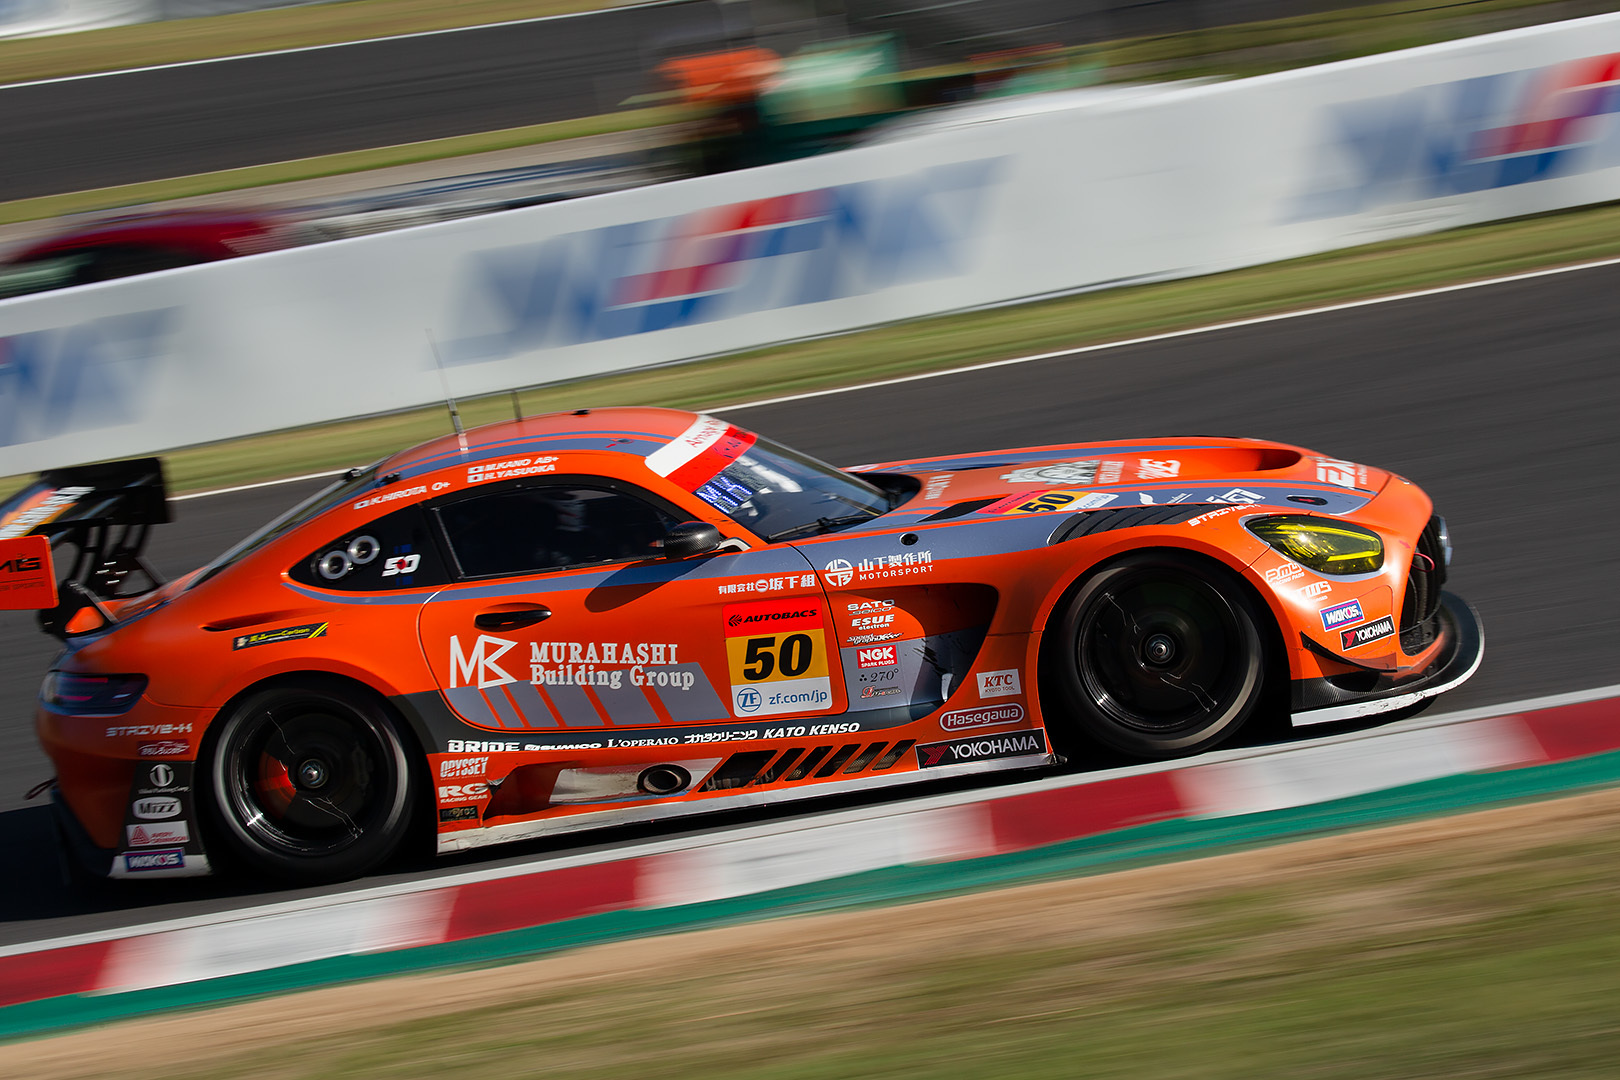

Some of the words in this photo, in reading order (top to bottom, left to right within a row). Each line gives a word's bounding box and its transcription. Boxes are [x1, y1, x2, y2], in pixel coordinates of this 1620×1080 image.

[1017, 493, 1075, 512] 50
[381, 553, 422, 577] 50
[858, 550, 932, 573] 山下製作所
[859, 564, 934, 581] MOTORSPORT
[847, 599, 896, 611] SATO
[743, 609, 818, 623] AUTOBACS
[851, 613, 895, 627] ESUE
[858, 622, 890, 631] electron
[1355, 620, 1393, 641] YOKOHAMA
[530, 641, 678, 665] MURAHASHI
[743, 633, 813, 681] 50
[860, 646, 894, 662] NGK
[861, 660, 877, 668] SPARK
[530, 663, 622, 690] Building
[629, 663, 695, 691] Group
[984, 674, 1013, 688] KTC
[738, 690, 761, 710] ZF
[769, 689, 828, 705] zf.com/jp
[947, 707, 1019, 727] Hasegawa
[763, 726, 806, 740] KATO
[808, 722, 860, 736] KENSO
[447, 739, 521, 753] BRIDE
[607, 736, 679, 748] L'OPERAIO
[949, 735, 1039, 760] YOKOHAMA
[440, 756, 489, 778] ODYSSEY
[438, 782, 489, 799] RG
[440, 795, 467, 804] RACING
